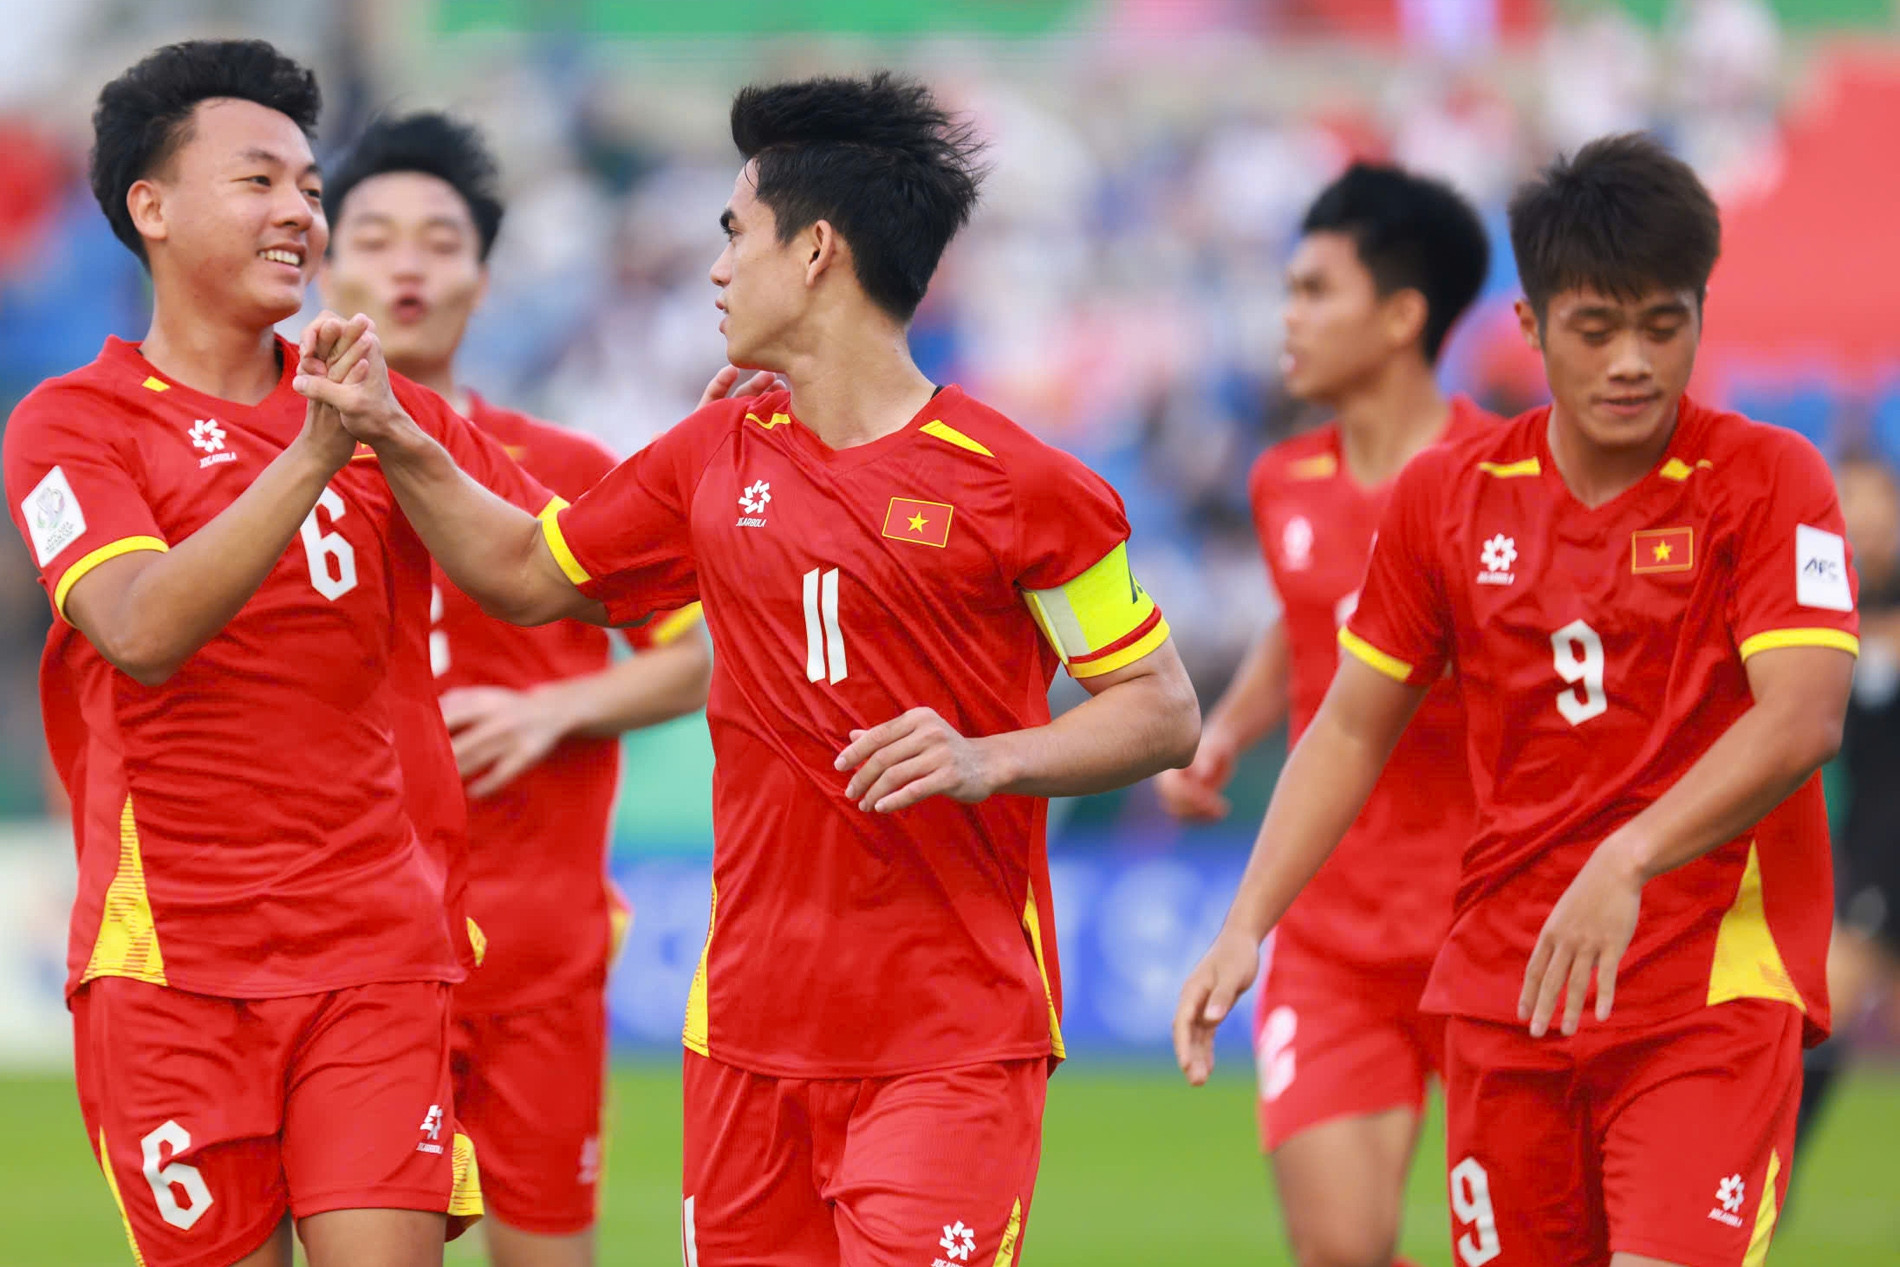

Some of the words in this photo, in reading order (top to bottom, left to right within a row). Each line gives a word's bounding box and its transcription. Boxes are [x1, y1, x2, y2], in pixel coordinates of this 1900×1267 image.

[300, 486, 358, 602] 6
[803, 567, 847, 686] 11
[1552, 619, 1607, 726] 9
[141, 1120, 214, 1231] 6
[1451, 1156, 1501, 1267] 9
